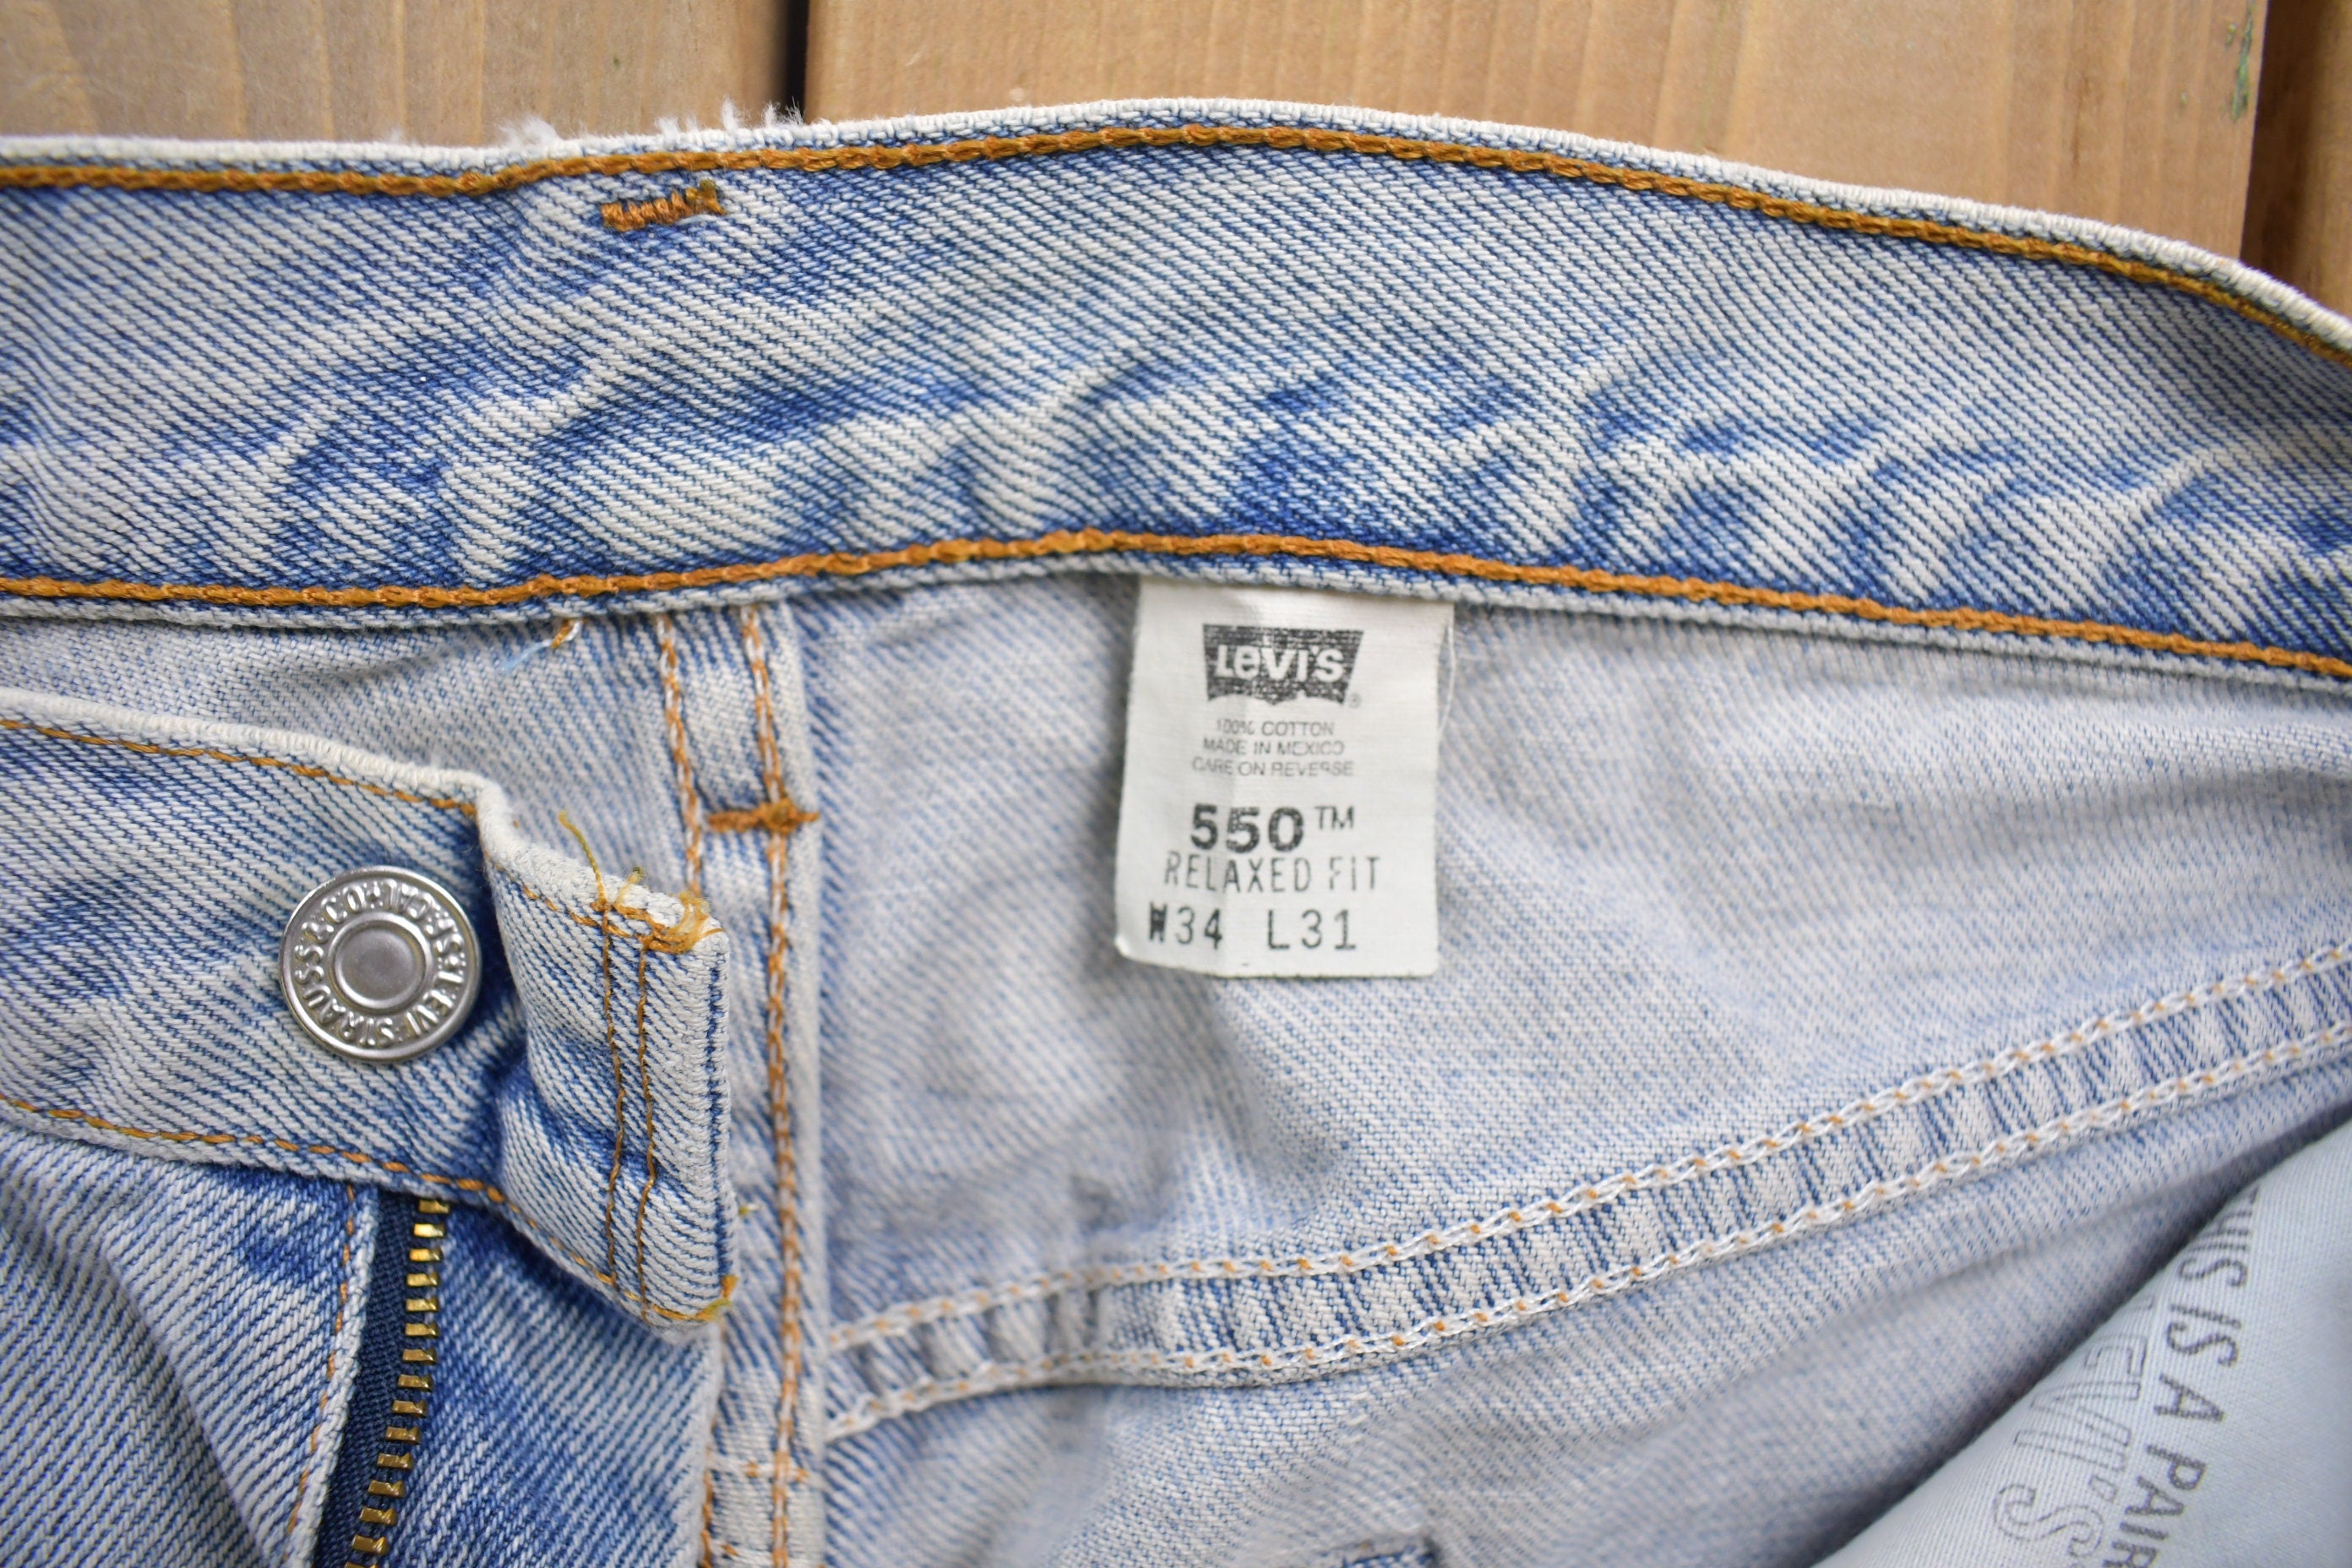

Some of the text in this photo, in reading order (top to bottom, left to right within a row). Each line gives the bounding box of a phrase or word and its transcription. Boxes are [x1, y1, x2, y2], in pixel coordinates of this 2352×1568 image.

[1204, 738, 1344, 756] MADE IN MEXICO
[1217, 719, 1335, 737] 100% COTTON
[1192, 756, 1354, 776] CARE ON REVERSE
[1164, 851, 1380, 893] RELAXED FIT
[1149, 901, 1356, 950] W34 L31
[295, 944, 395, 1047] STRAUSS
[406, 971, 465, 1036] LEVI
[2102, 1186, 2259, 1568] HIS IS A PAIR
